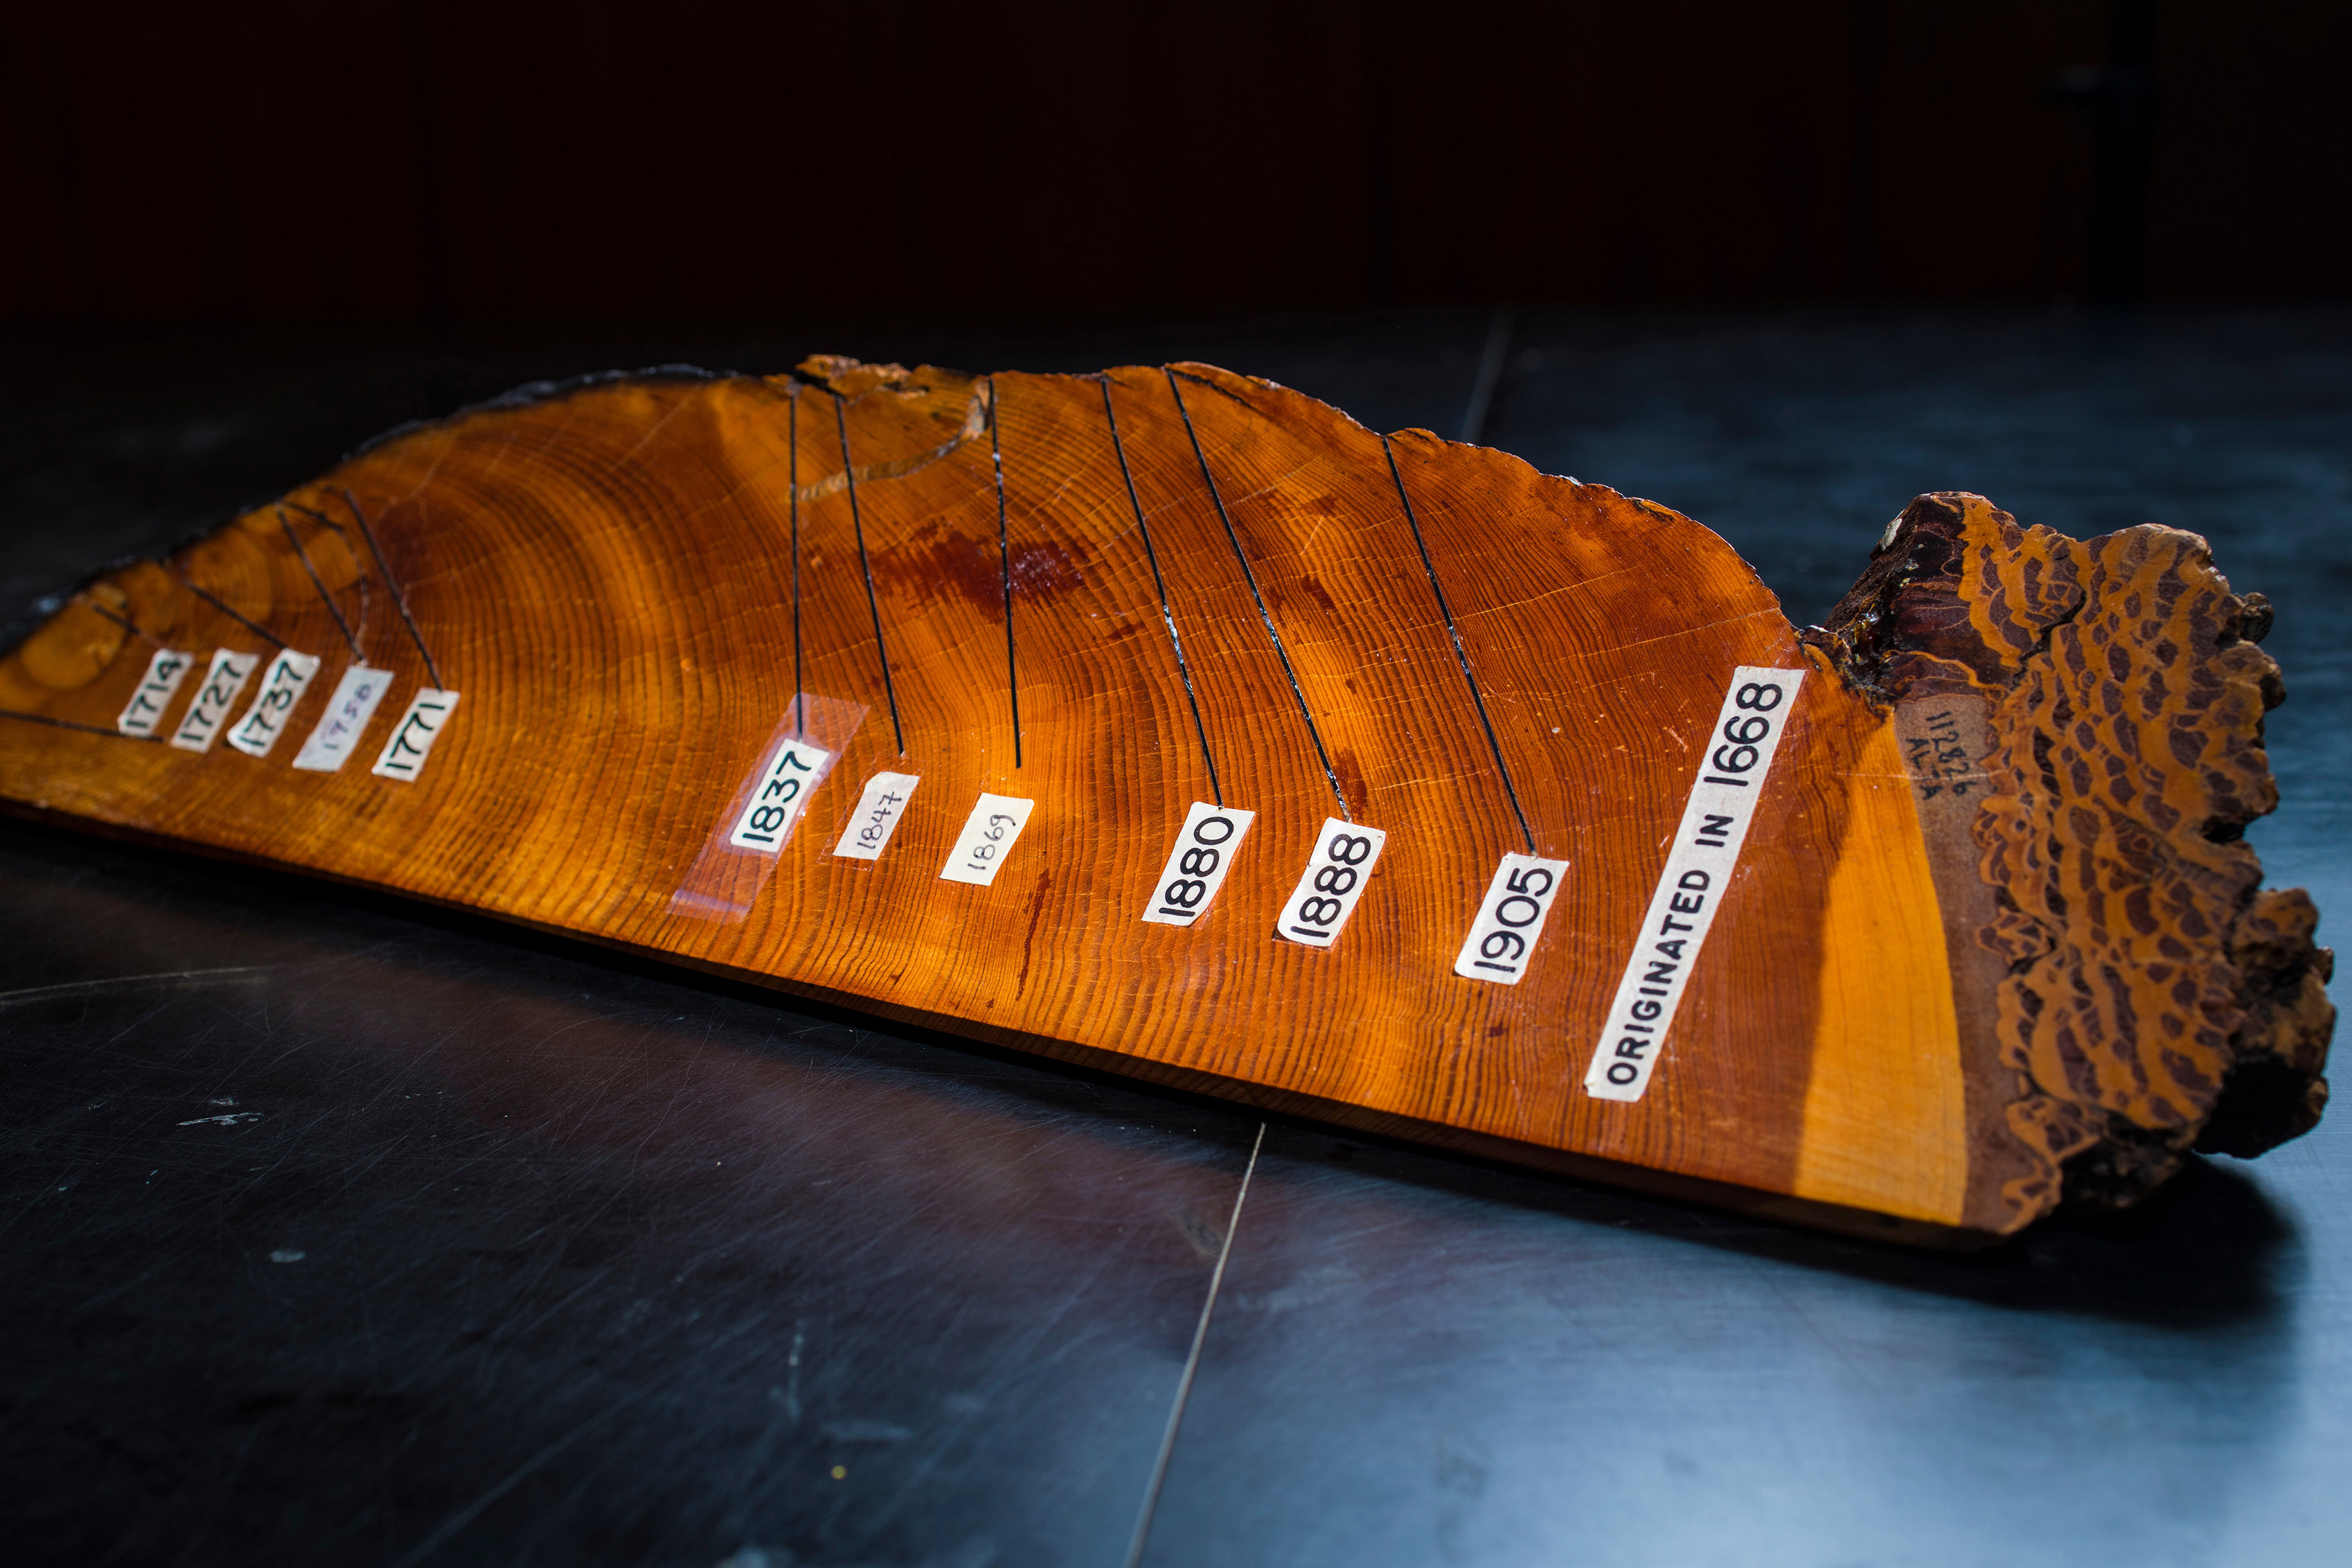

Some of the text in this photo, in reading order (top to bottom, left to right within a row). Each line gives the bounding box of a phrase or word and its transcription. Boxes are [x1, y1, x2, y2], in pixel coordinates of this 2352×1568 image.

[125, 659, 182, 728] 1714
[180, 661, 241, 742] 1727
[238, 660, 303, 747] 1737
[386, 702, 445, 771] 1771
[1926, 711, 1978, 796] 112826
[742, 751, 812, 844] 1837
[857, 791, 902, 850] 1847
[967, 814, 1016, 871] 1869
[1159, 816, 1234, 918] 1880
[1290, 833, 1371, 938] 1888
[1607, 681, 1783, 1085] ORIGINATED IN 1668
[1474, 867, 1553, 973] 1905
